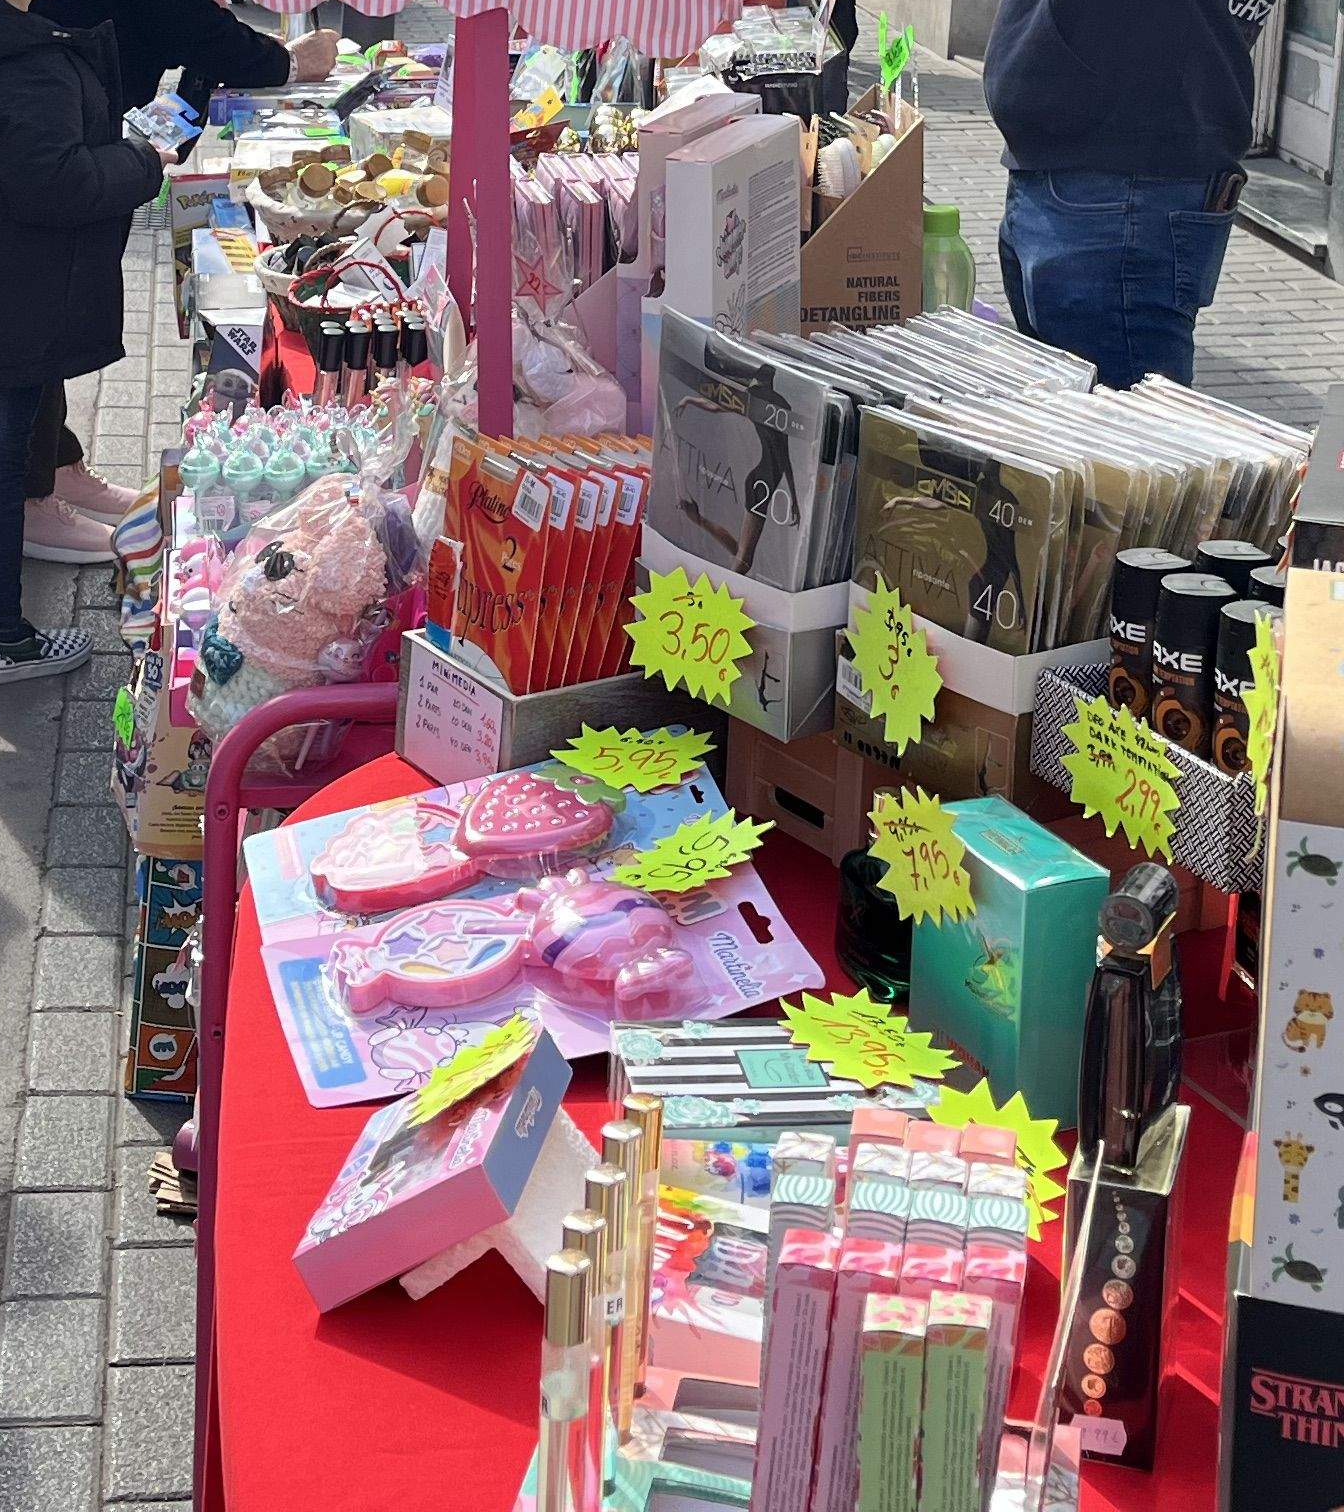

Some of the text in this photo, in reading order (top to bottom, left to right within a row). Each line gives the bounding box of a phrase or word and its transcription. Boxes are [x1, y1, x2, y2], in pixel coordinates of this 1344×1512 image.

[846, 275, 901, 289] NATURAL
[857, 290, 901, 303] FIBERS
[800, 304, 901, 324] DETANGLING
[227, 334, 256, 356] WARS
[230, 326, 258, 351] STAR
[764, 403, 788, 432] 20
[750, 480, 791, 526] 20
[917, 476, 973, 511] OMSA
[988, 499, 1015, 528] 40
[973, 583, 1018, 630] 40
[1089, 725, 1117, 751] DARK
